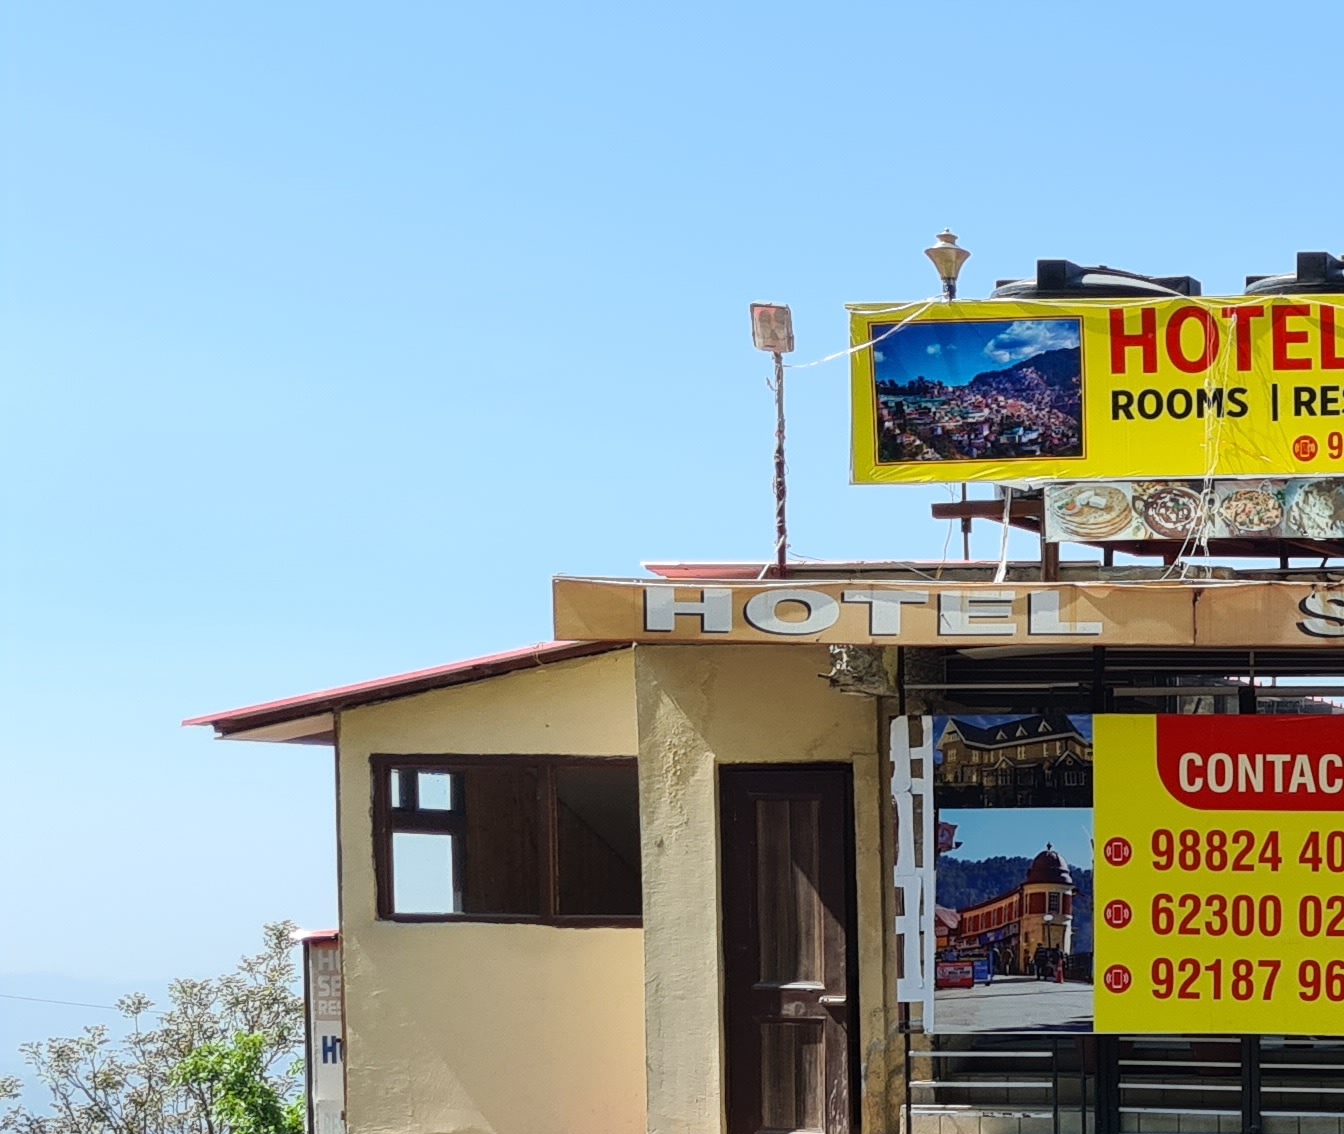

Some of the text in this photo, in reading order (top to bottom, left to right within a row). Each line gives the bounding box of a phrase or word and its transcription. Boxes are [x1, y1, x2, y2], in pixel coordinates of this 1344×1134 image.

[1111, 387, 1249, 420] ROOMS
[643, 587, 1103, 636] HOTEL
[1151, 828, 1283, 872] 98824
[1151, 893, 1282, 937] 62300
[1151, 957, 1282, 1001] 92187
